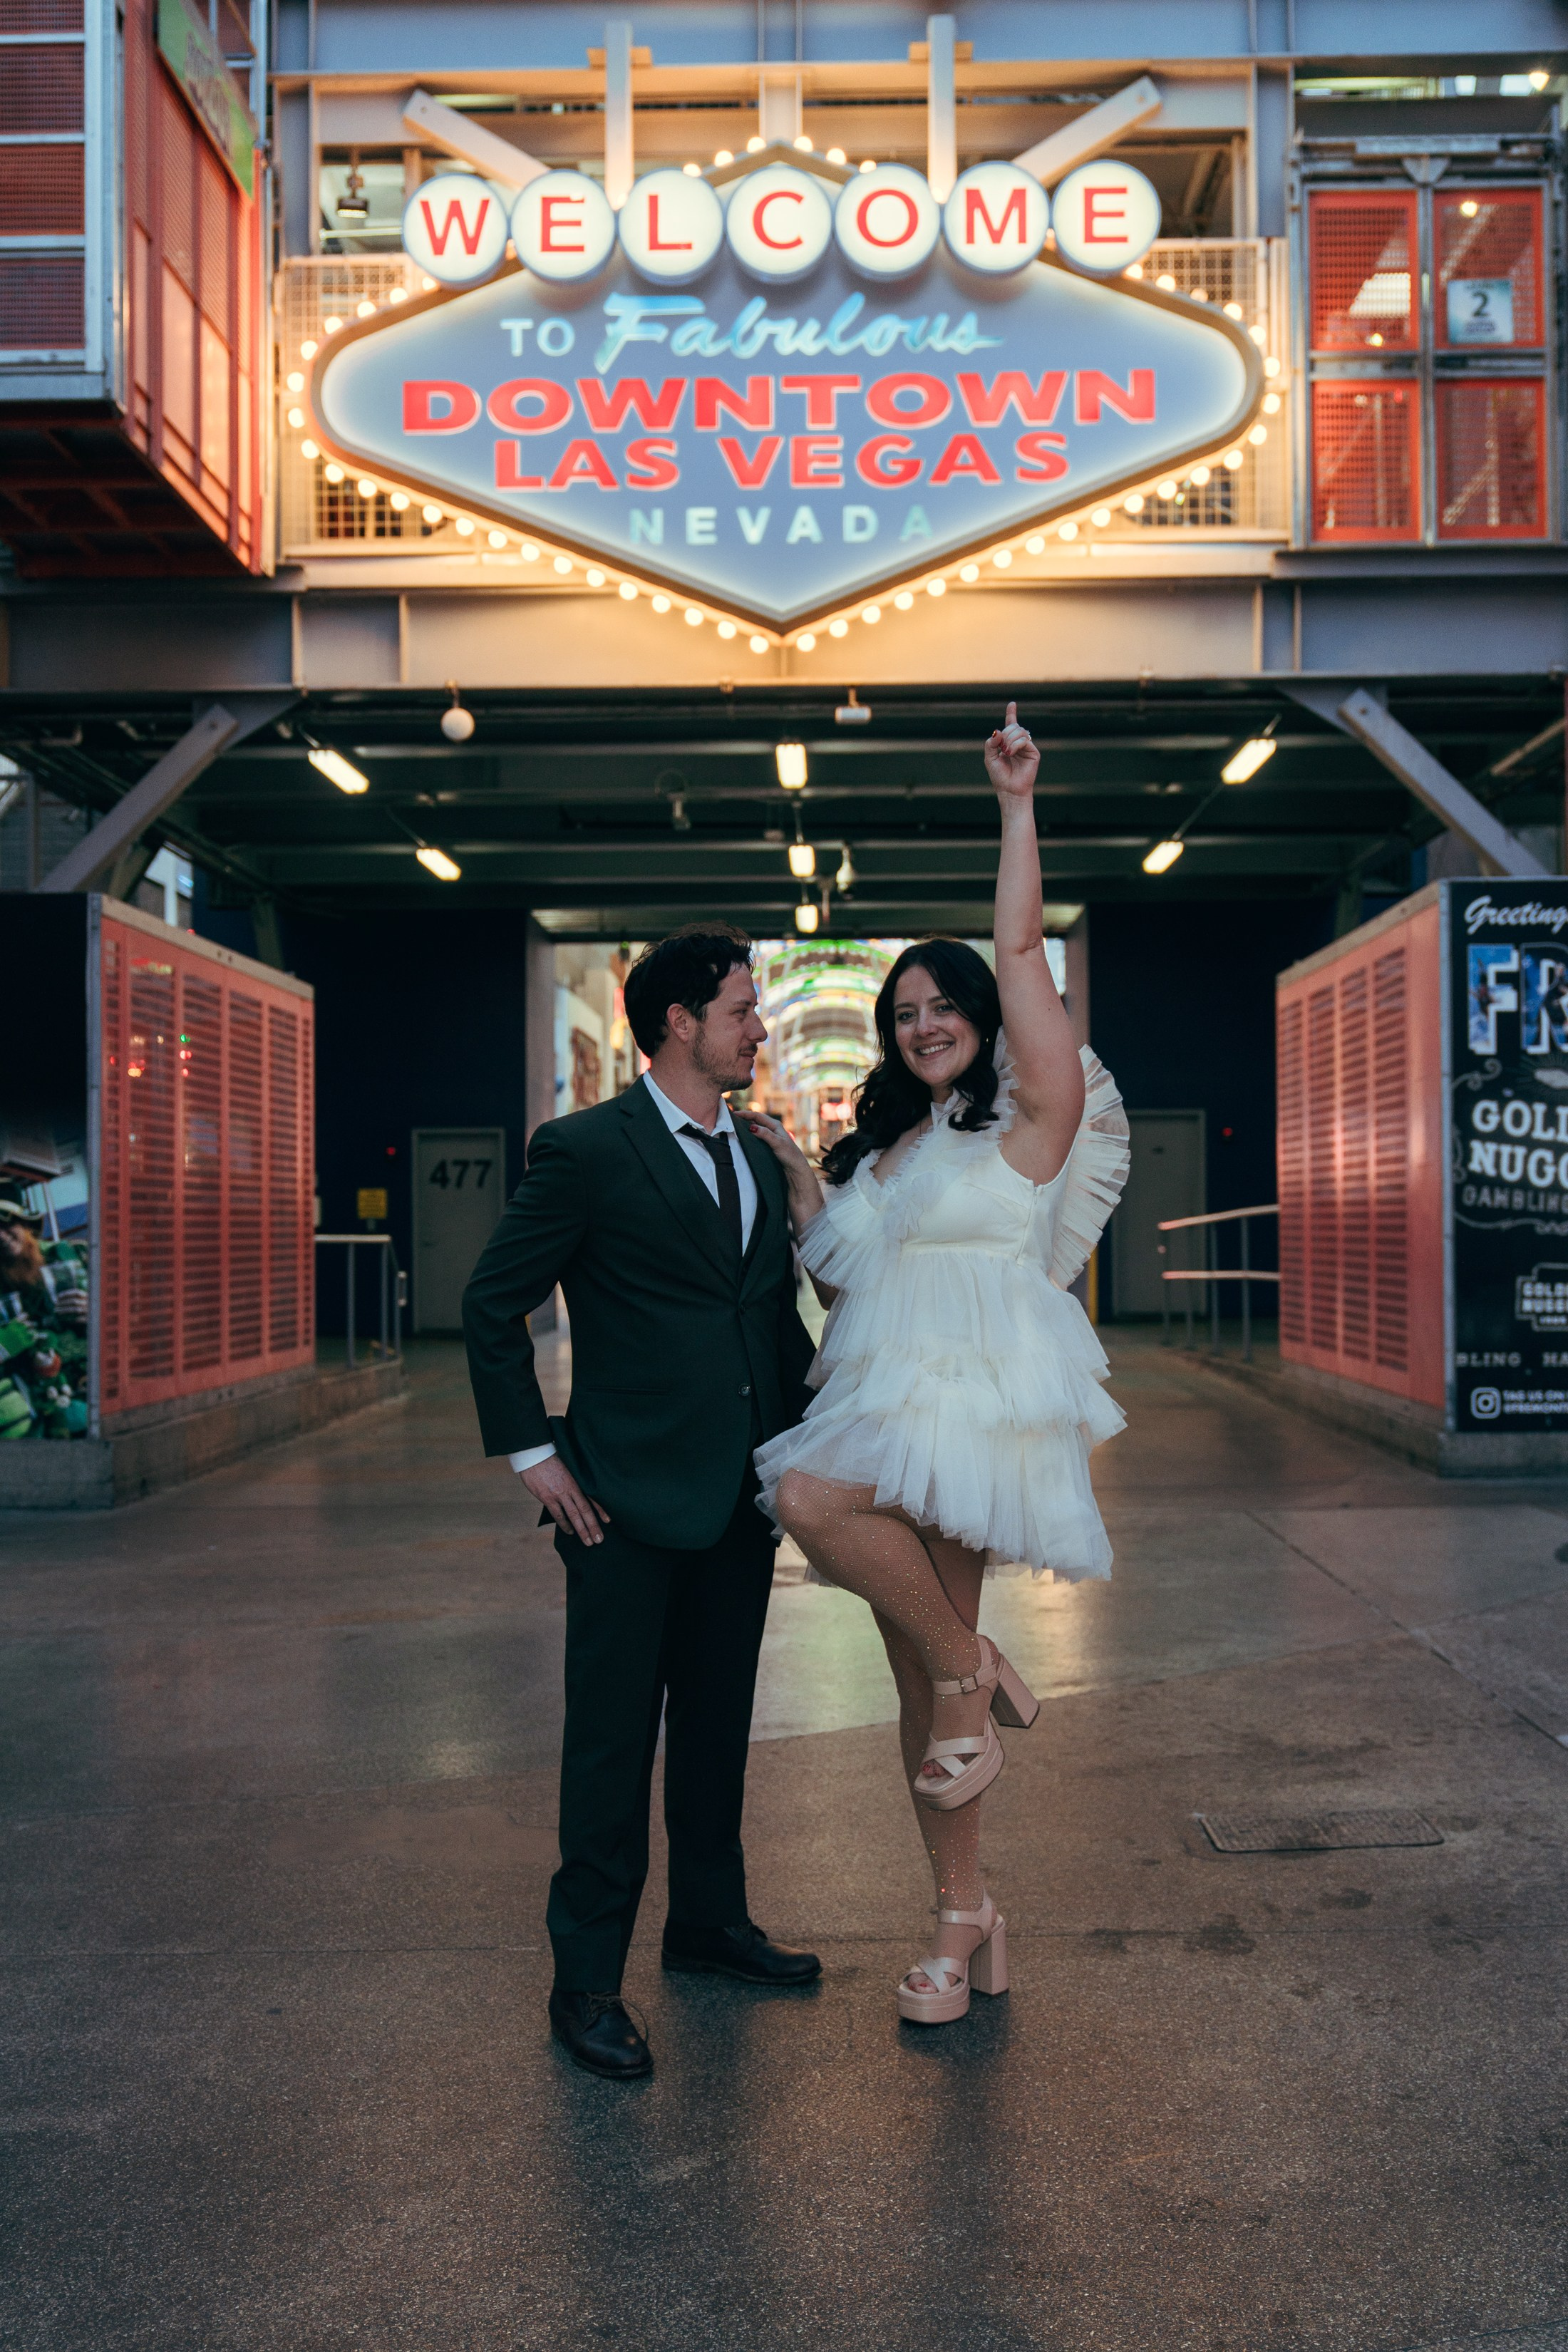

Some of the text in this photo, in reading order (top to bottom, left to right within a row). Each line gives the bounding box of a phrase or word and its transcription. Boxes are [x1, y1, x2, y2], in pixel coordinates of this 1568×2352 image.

[420, 186, 1130, 257] WELCOME
[500, 291, 1004, 373] TO Fabulous
[1471, 291, 1489, 317] 2
[402, 368, 1156, 436] DOWNTOWN
[493, 431, 1070, 492] LAS VEGAS
[628, 504, 934, 545] NEVADA
[429, 1159, 491, 1190] 477
